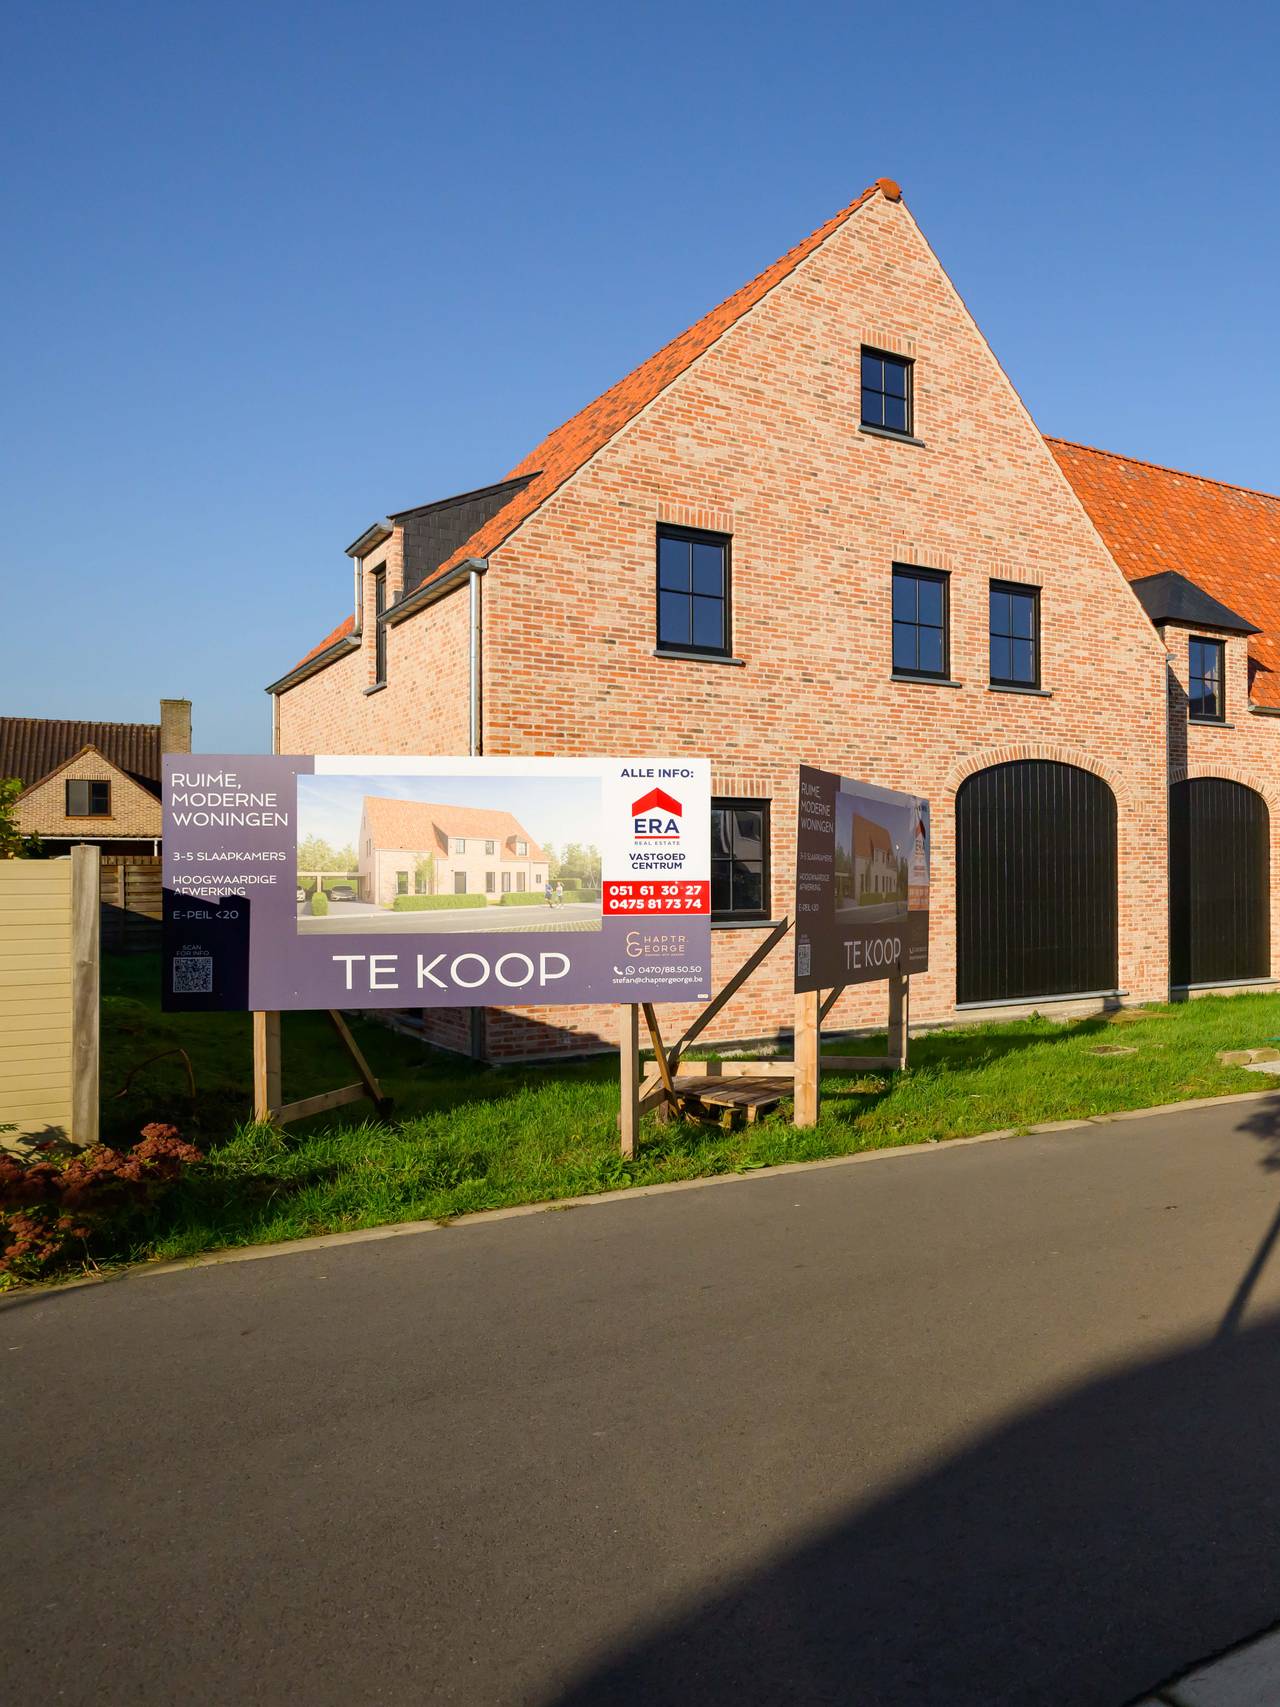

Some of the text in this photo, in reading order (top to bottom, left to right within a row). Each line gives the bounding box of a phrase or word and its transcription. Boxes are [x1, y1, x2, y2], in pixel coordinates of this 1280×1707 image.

[620, 768, 694, 778] ALLE INFO:
[171, 773, 242, 790] RUIME,
[171, 792, 278, 807] MODERNE
[800, 801, 831, 817] MODERNE
[172, 812, 289, 827] WONINGEN
[634, 818, 680, 834] ERA
[800, 818, 834, 833] WONINGEN
[172, 851, 287, 861] 3-5 SLAAPKAMERS
[629, 853, 686, 861] VASTGOED
[631, 862, 683, 870] CENTRUM
[172, 875, 278, 885] HOOGWAARDIGE
[173, 887, 246, 897] AFWERKING
[609, 885, 702, 896] 051 61 30 27
[609, 898, 702, 910] 0475 81 73 74
[173, 910, 239, 920] E-PEIL <20
[844, 940, 862, 969] TE
[865, 937, 901, 968] KOOP
[332, 952, 571, 990] TE KOOP
[638, 965, 702, 975] 0470/88.50.50
[612, 976, 703, 985] stefan@chaptergeorge.be
